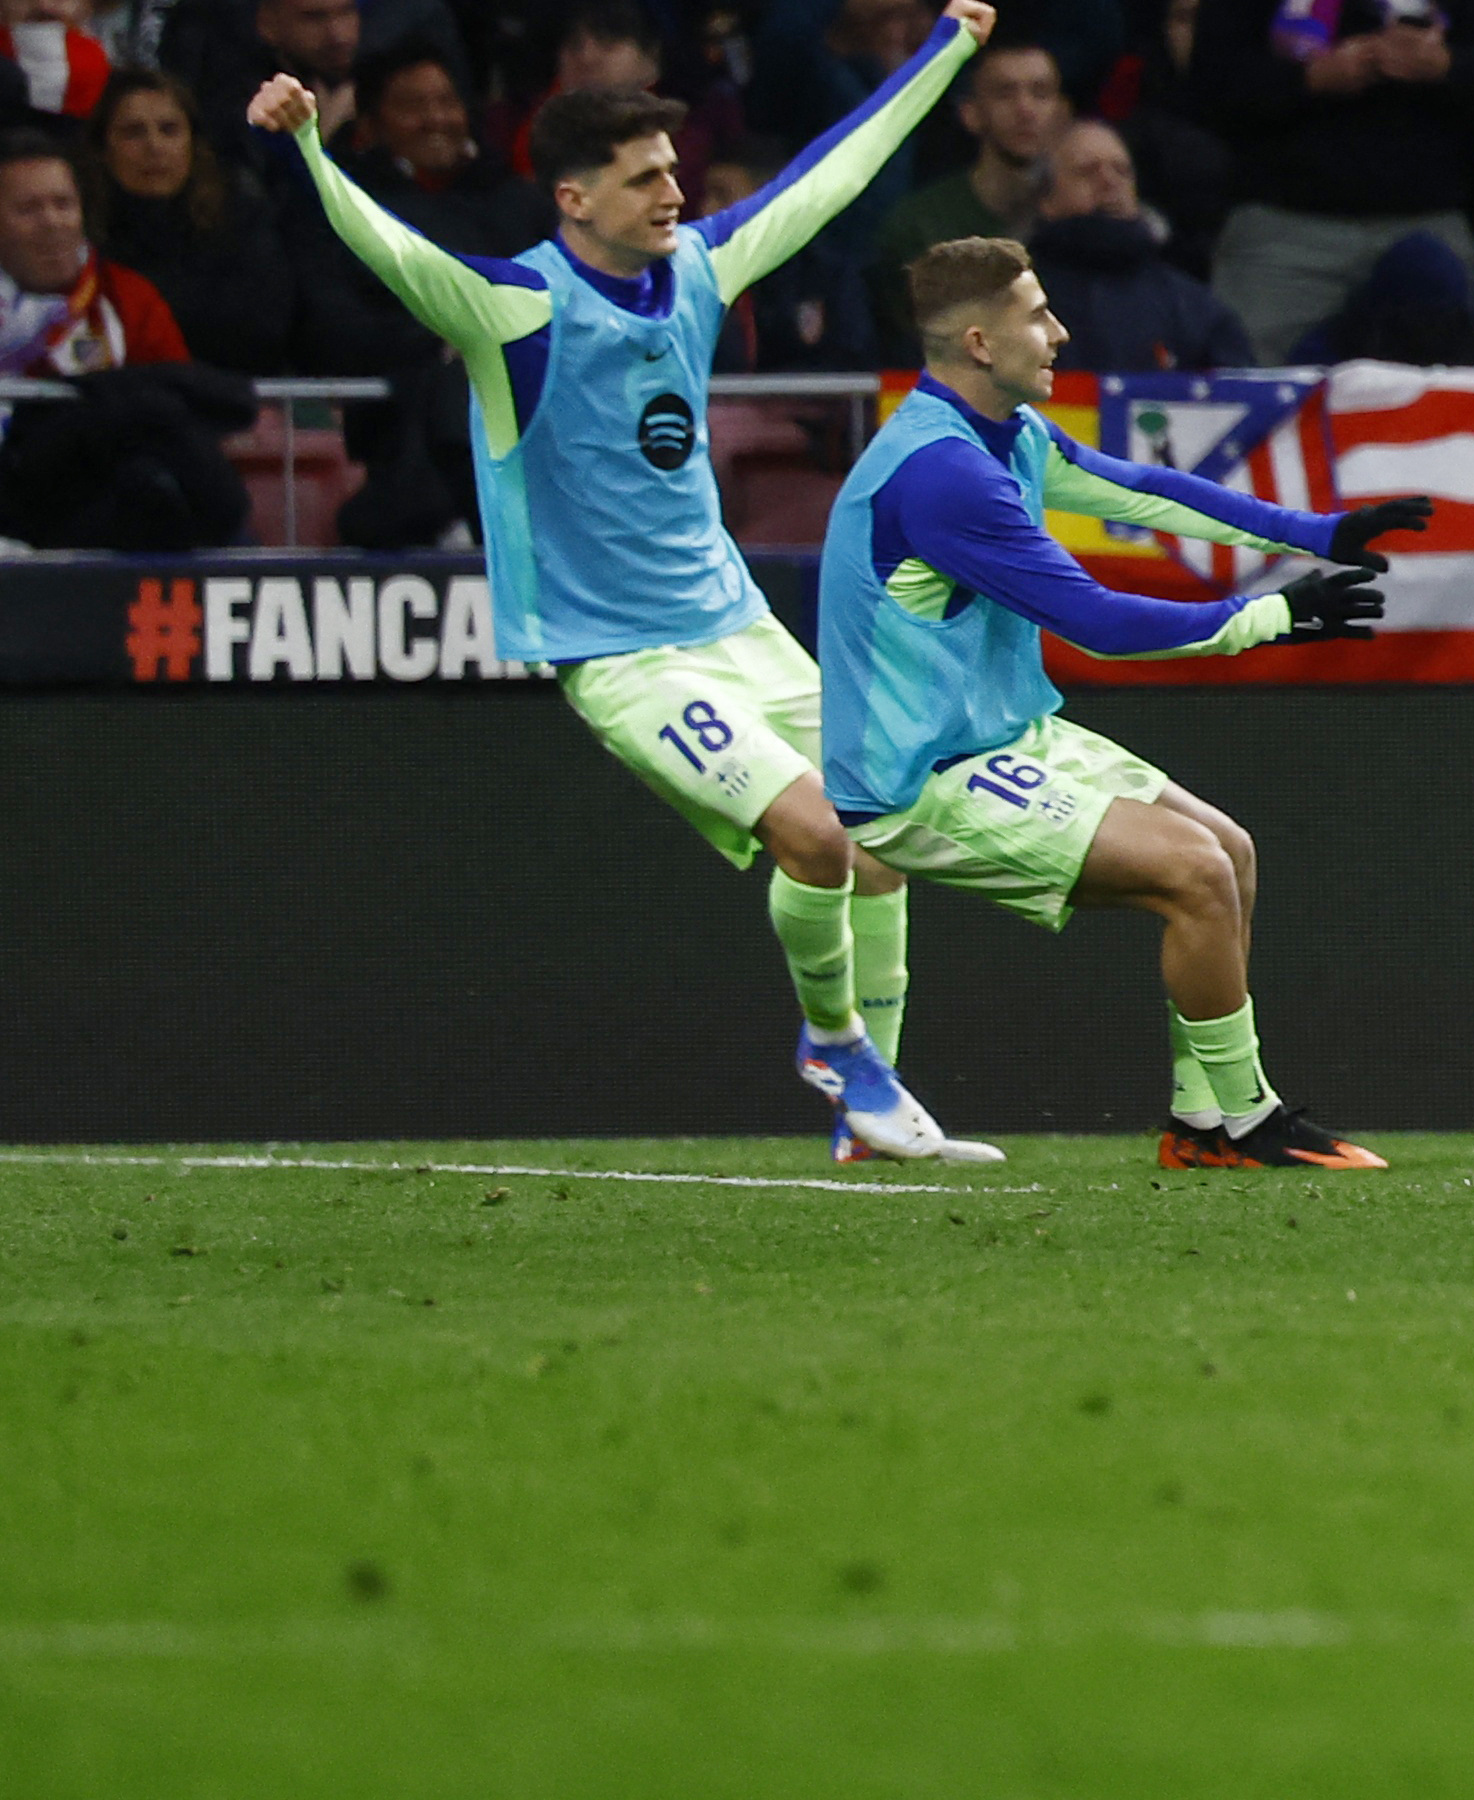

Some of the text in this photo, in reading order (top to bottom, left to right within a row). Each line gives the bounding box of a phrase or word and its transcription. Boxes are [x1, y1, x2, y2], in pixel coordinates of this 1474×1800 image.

[126, 574, 557, 682] #FANCA
[659, 700, 733, 775] 18
[967, 755, 1046, 810] 16
